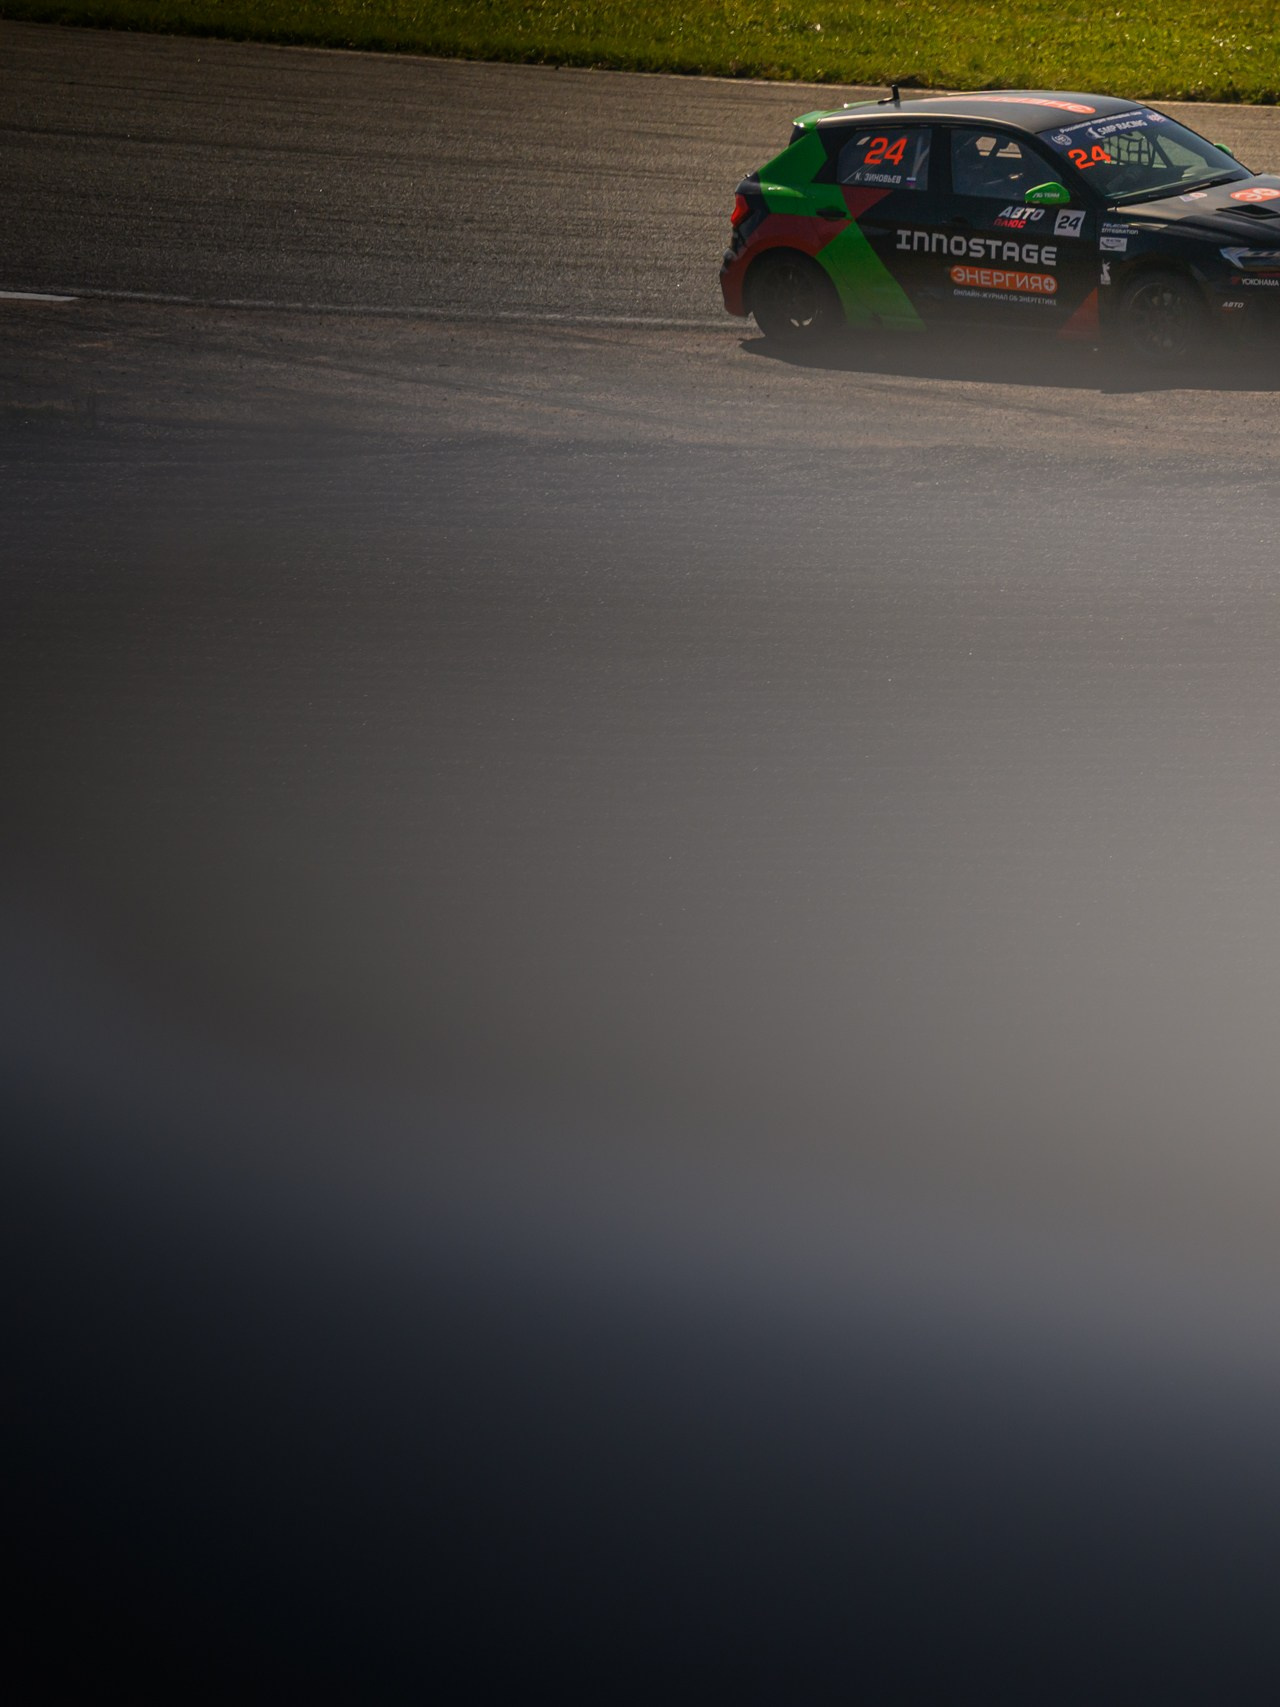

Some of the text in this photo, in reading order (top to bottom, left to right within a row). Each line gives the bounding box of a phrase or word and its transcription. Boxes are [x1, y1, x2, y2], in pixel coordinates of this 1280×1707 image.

[863, 136, 908, 166] 24
[1067, 145, 1112, 170] 24
[863, 173, 902, 184] ЗИНОВЬЕВ
[998, 206, 1046, 221] АВТО
[1057, 215, 1081, 231] 24
[896, 229, 1057, 266] INNOSTAGE
[1241, 278, 1280, 287] YOKOHAMA
[1222, 301, 1245, 309] АВТО
